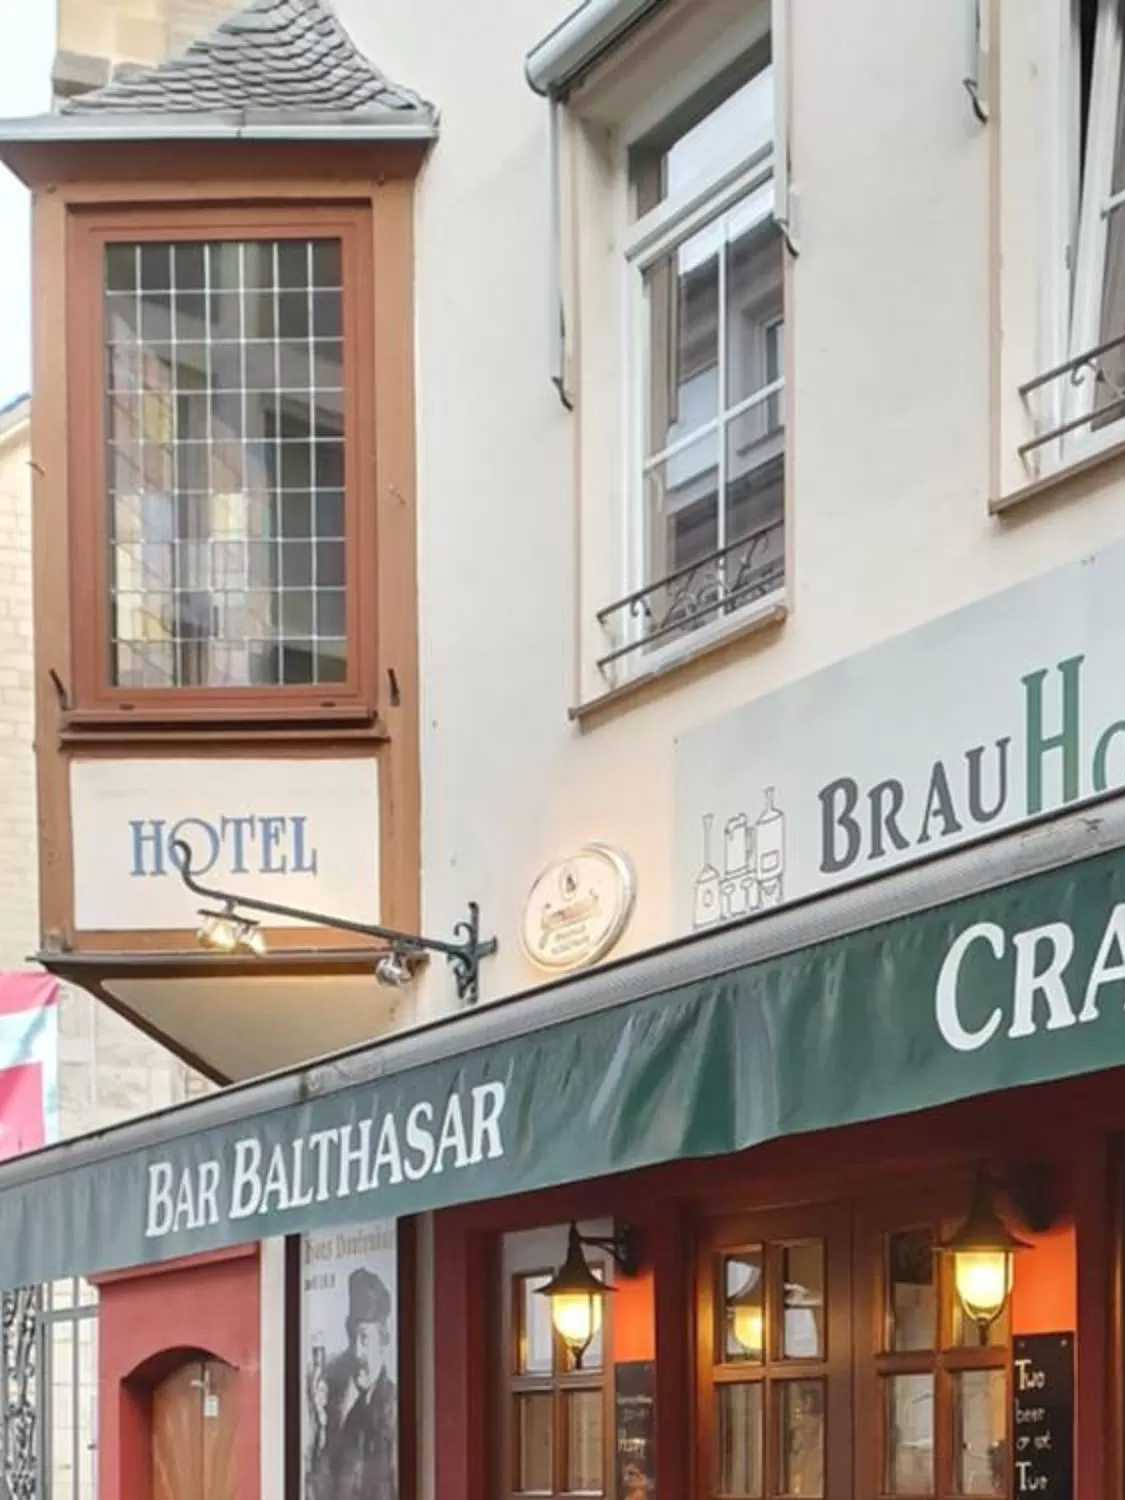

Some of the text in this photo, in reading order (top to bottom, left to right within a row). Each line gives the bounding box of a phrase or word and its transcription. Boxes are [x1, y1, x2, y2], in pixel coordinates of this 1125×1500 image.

[129, 815, 318, 877] HOTEL
[145, 1081, 506, 1237] BAR BALTHASAR
